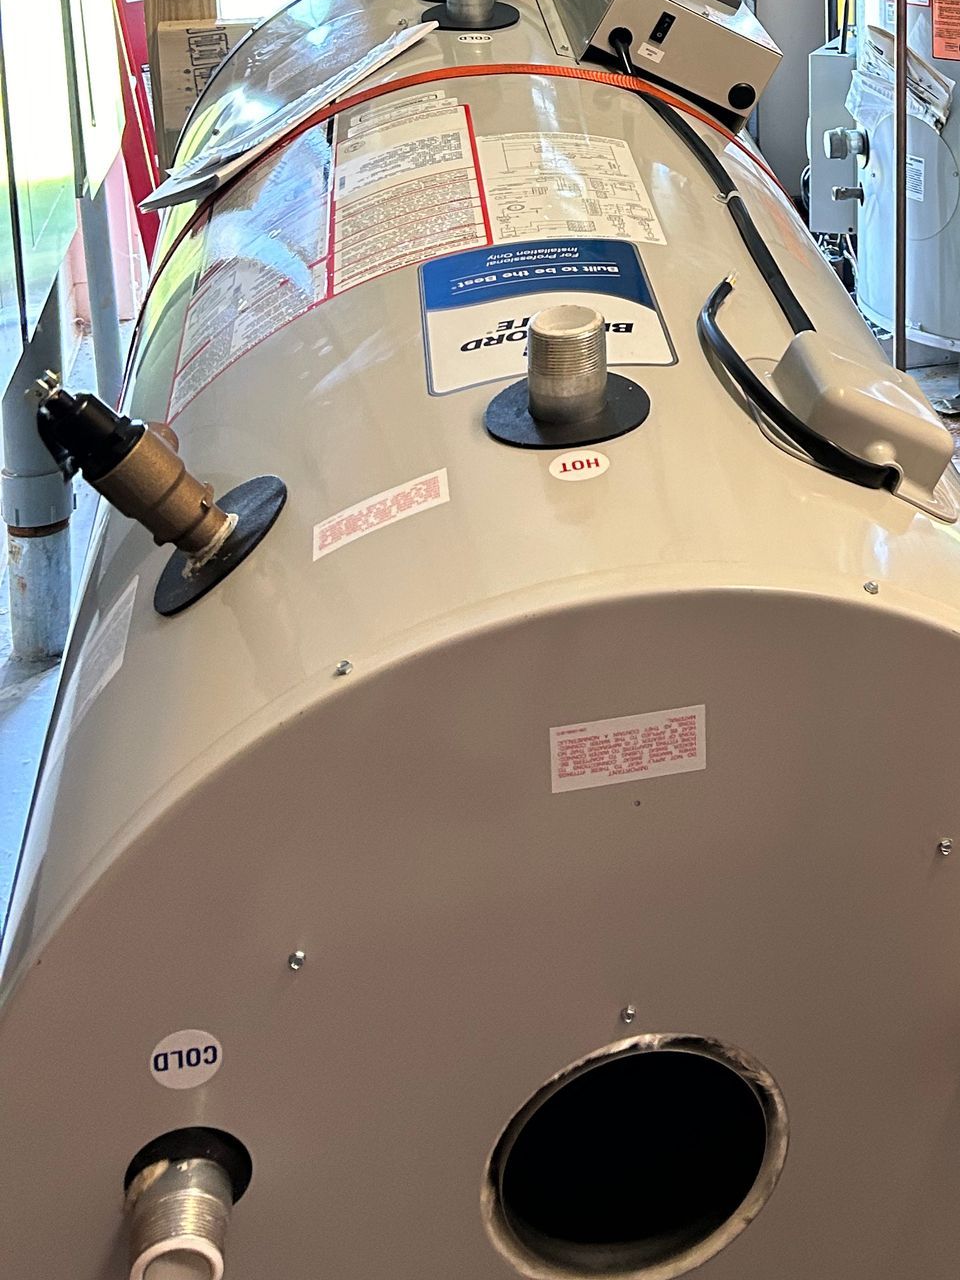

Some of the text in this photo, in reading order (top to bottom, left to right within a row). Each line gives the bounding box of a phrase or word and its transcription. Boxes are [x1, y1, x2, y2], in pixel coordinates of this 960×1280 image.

[486, 253, 557, 267] Professional
[487, 247, 578, 261] Installation Only
[458, 265, 620, 289] Built to be the Best
[559, 457, 600, 473] HOT
[153, 1045, 218, 1072] COLD
